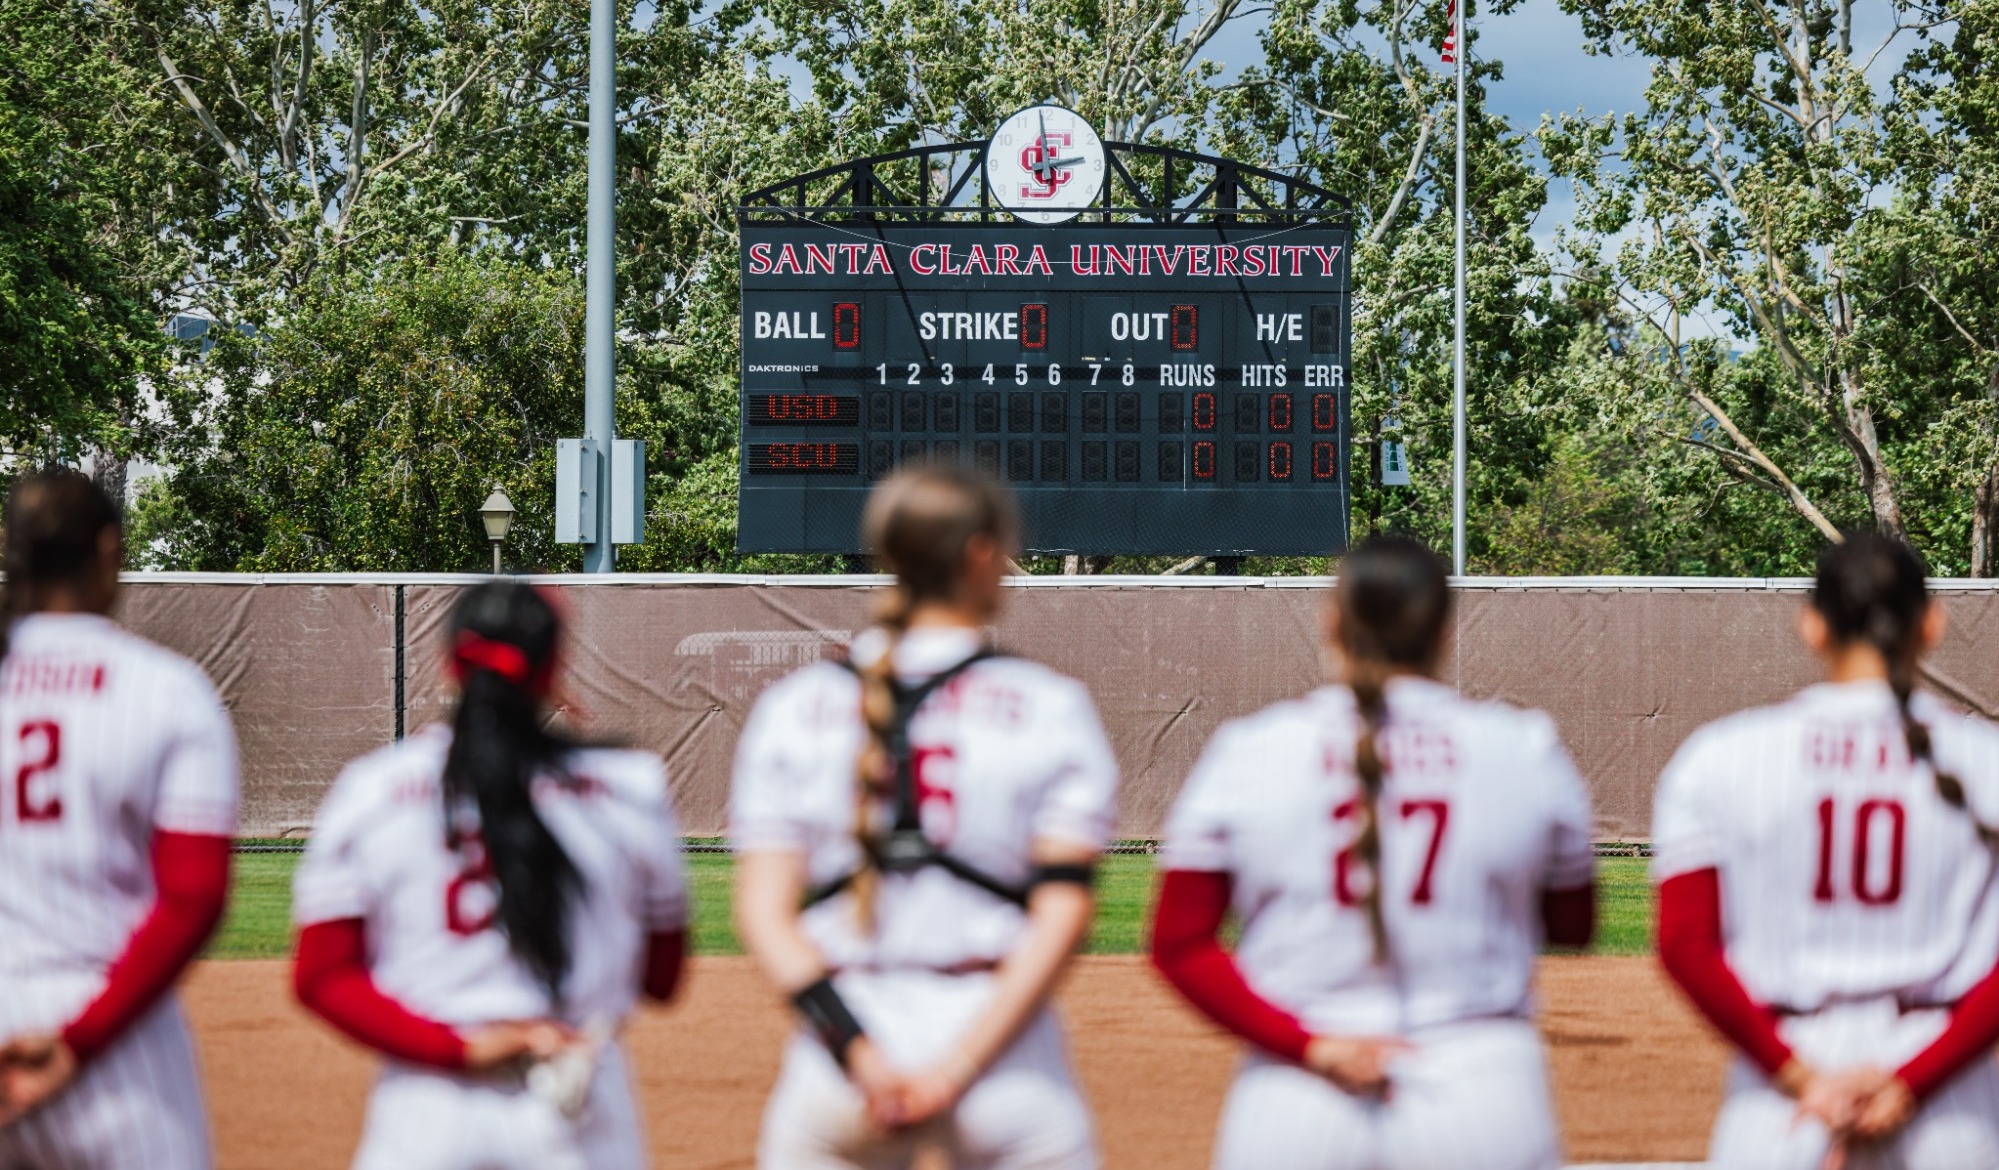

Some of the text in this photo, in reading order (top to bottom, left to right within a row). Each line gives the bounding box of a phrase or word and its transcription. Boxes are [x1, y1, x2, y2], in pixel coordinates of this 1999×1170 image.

[998, 134, 1013, 147] 10
[1086, 133, 1096, 146] 2
[989, 159, 999, 172] 9
[1093, 159, 1103, 172] 3
[1085, 184, 1094, 196] 4
[749, 243, 1343, 277] SANTA CLARA UNIVERSITY
[754, 311, 826, 339] BALL
[833, 303, 860, 348] 0
[919, 312, 1018, 340] STRIKE
[1021, 304, 1047, 348] 0
[1111, 312, 1169, 341] OUT
[1171, 305, 1198, 349] 0
[1256, 313, 1304, 344] H/E
[749, 364, 819, 373] DAKTRONICS
[876, 363, 1345, 388] 1 2 3 4 5 6 7 8 RUNS HITS ERR
[768, 393, 1335, 430] USD 0 0 0
[768, 441, 1335, 478] SCU 0 0 0
[15, 717, 64, 826] 2
[1331, 797, 1449, 905] 27
[1813, 796, 1906, 908] 10
